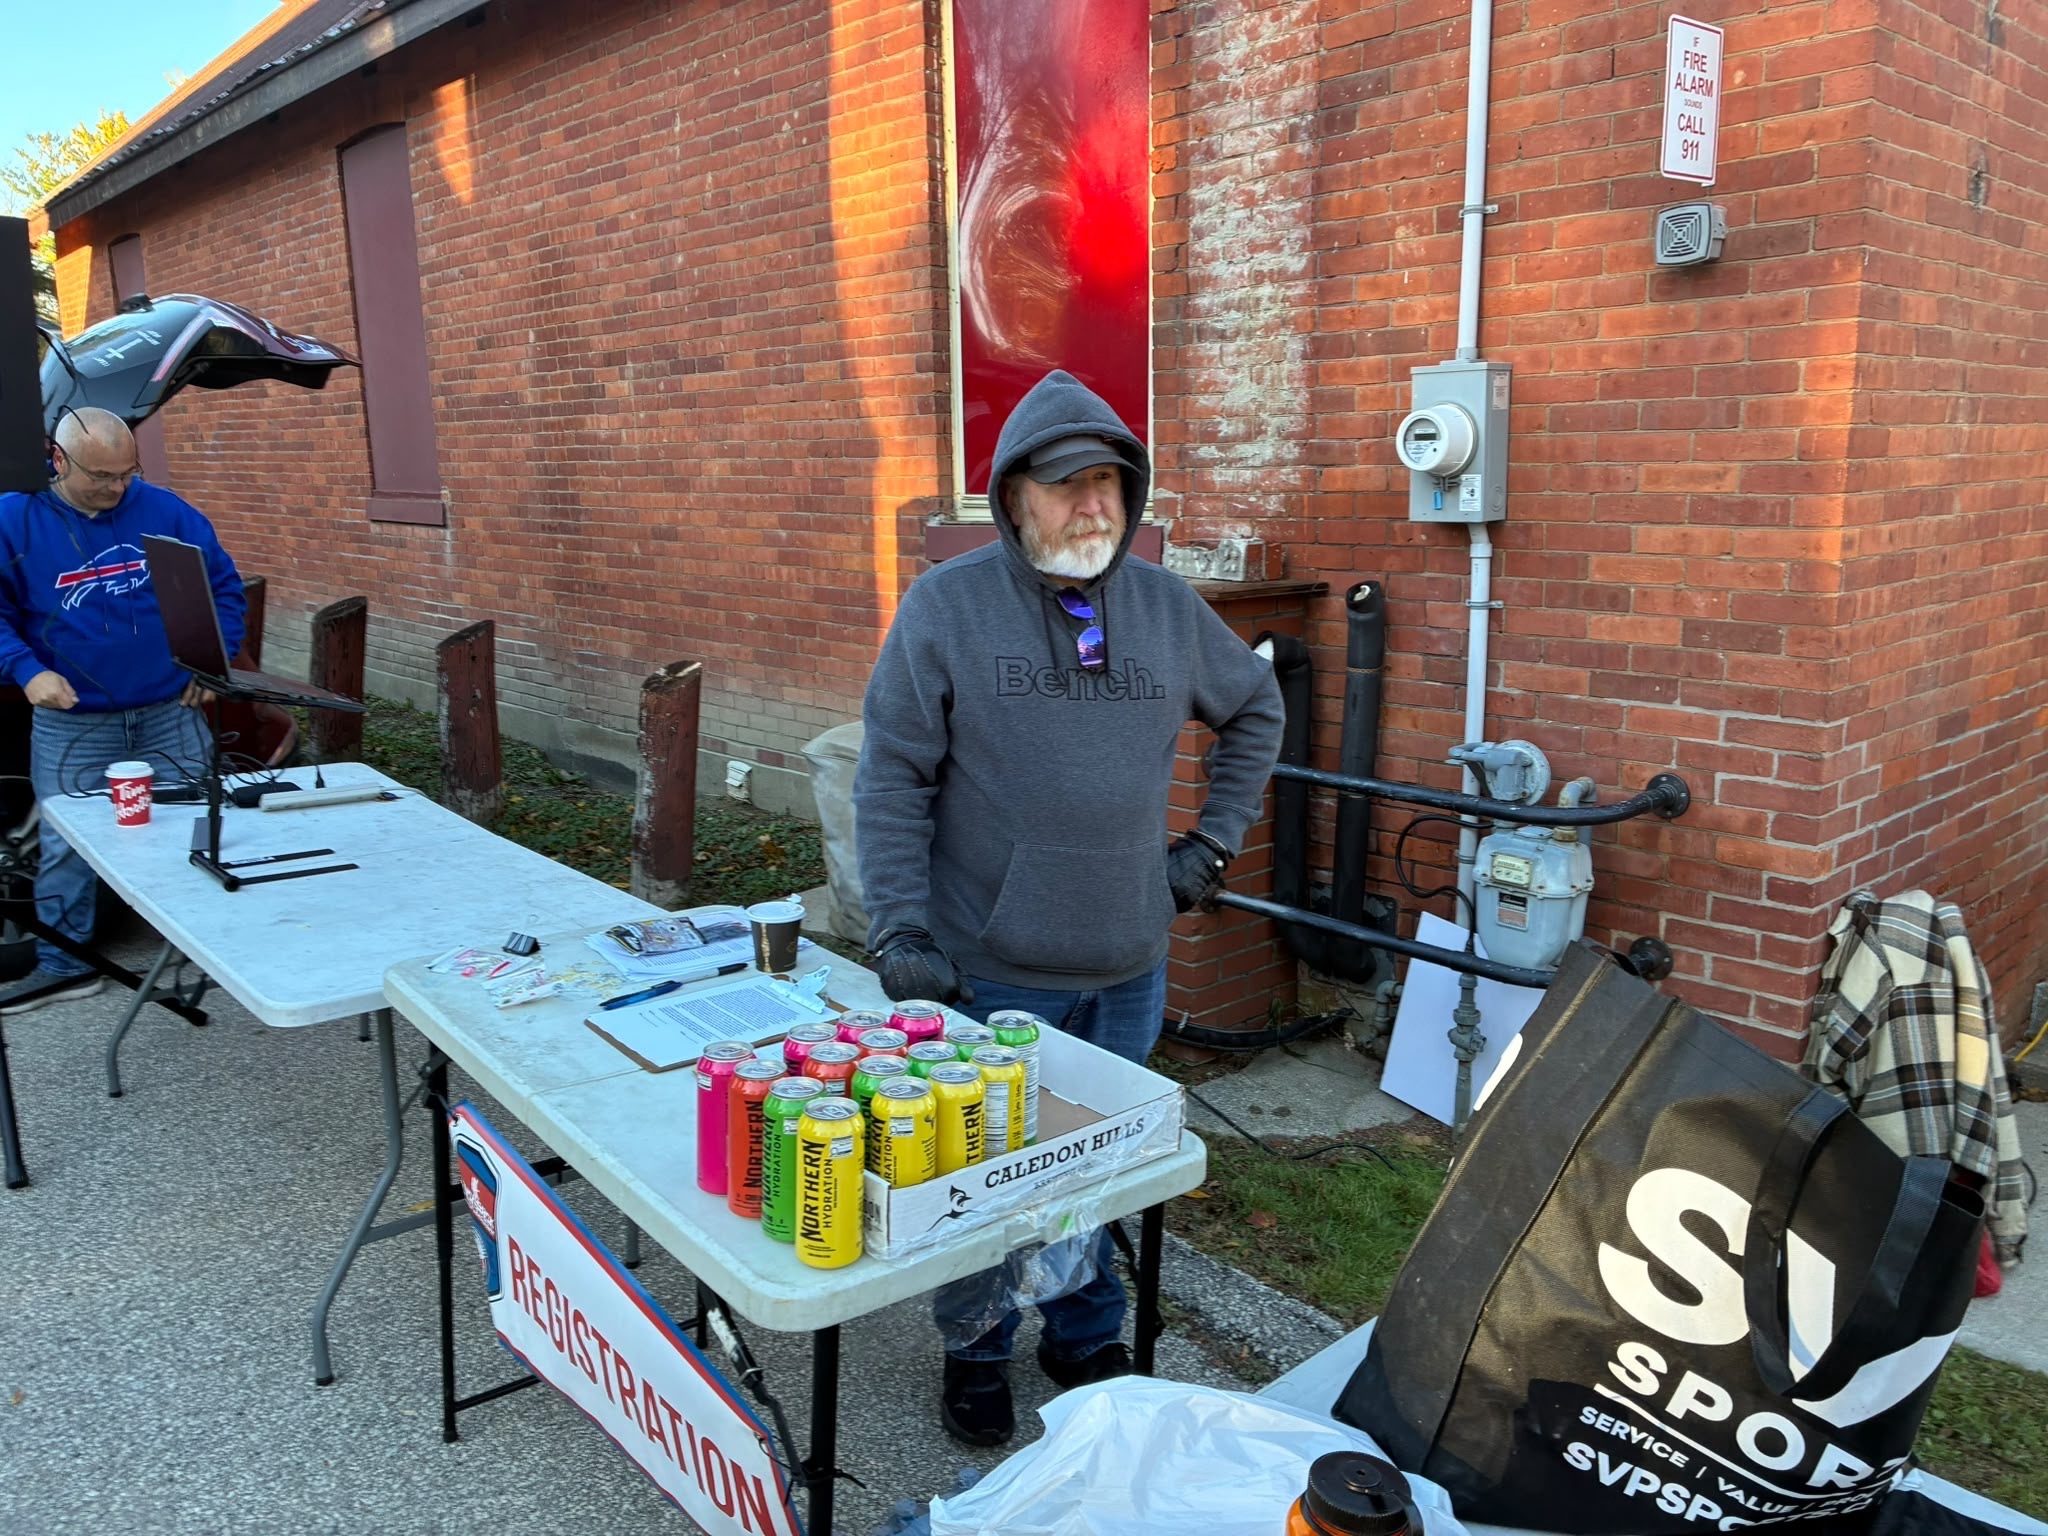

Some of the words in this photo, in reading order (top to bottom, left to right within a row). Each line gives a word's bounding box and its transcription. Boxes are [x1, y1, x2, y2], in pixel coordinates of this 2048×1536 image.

[1674, 71, 1714, 98] ALARM
[1682, 50, 1708, 73] FIRE
[1677, 113, 1706, 136] CALL
[1681, 139, 1700, 162] 911
[960, 1100, 983, 1165] THERN
[985, 1139, 1087, 1189] CALEDON
[1091, 1117, 1145, 1151] HILLS
[773, 1133, 782, 1198] HYDRATION
[800, 1138, 826, 1243] NORTHERN
[823, 1158, 833, 1229] HYDRATION
[508, 1234, 777, 1536] REGISTRATION
[1579, 1406, 1690, 1468] SERVICE
